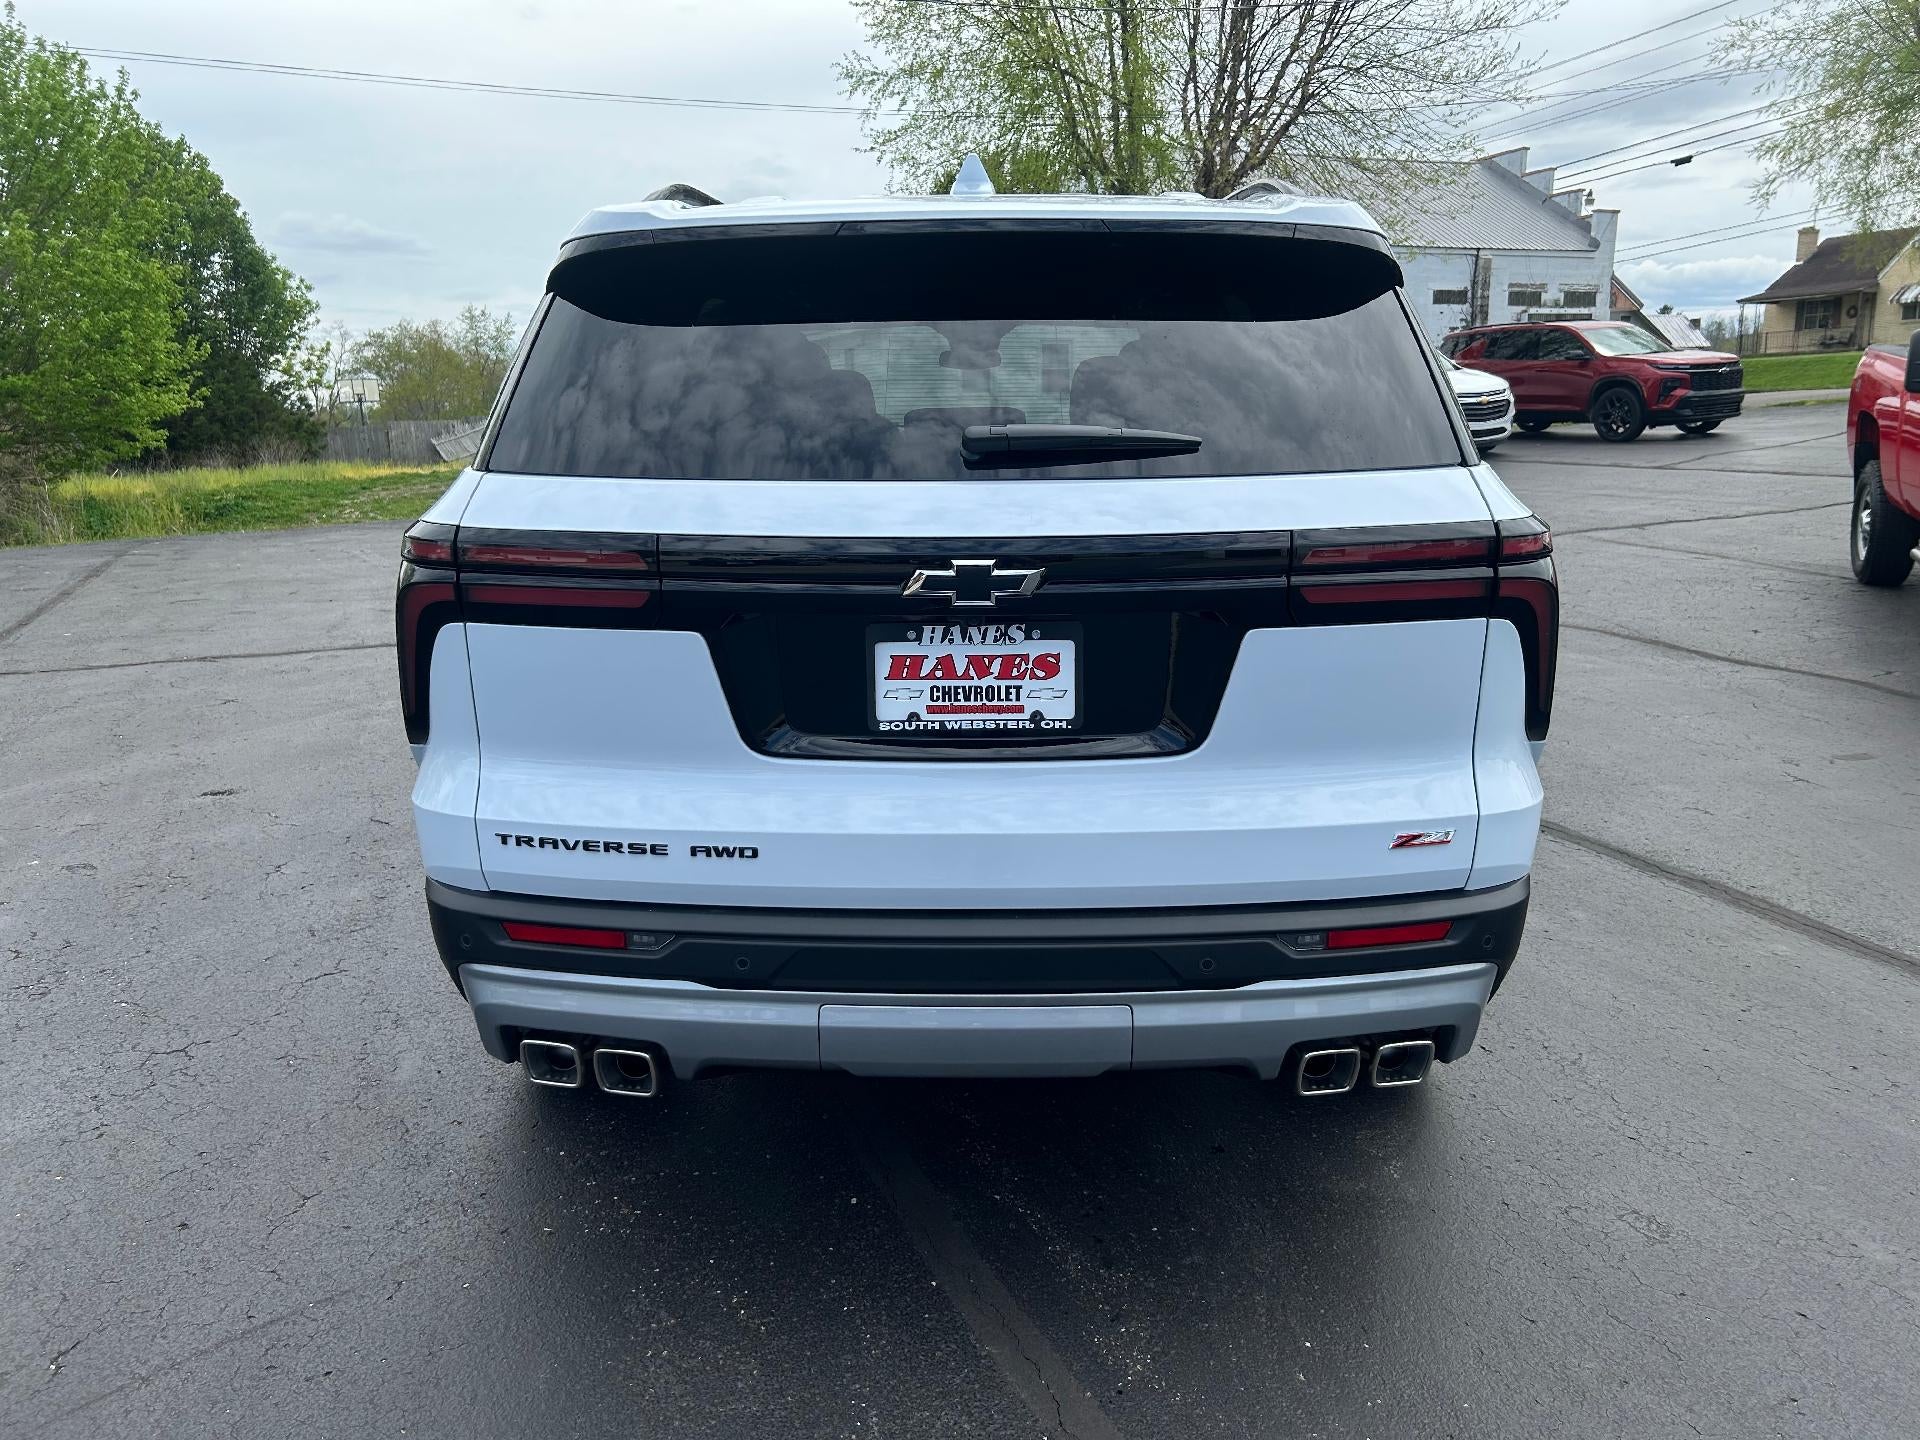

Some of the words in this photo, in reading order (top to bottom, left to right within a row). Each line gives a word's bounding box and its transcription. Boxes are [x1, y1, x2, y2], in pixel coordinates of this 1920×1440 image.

[918, 624, 1026, 646] HANES
[884, 652, 1061, 681] HANES
[929, 685, 1023, 702] CHEVROLET
[926, 703, 1025, 715] www.haneschevy.com
[879, 721, 940, 731] SOUTH
[944, 720, 1035, 730] WEBSTER,
[1040, 720, 1072, 730] OH.
[495, 832, 669, 857] TRAVERSE
[690, 845, 759, 859] AWD
[1388, 829, 1457, 850] Z71
